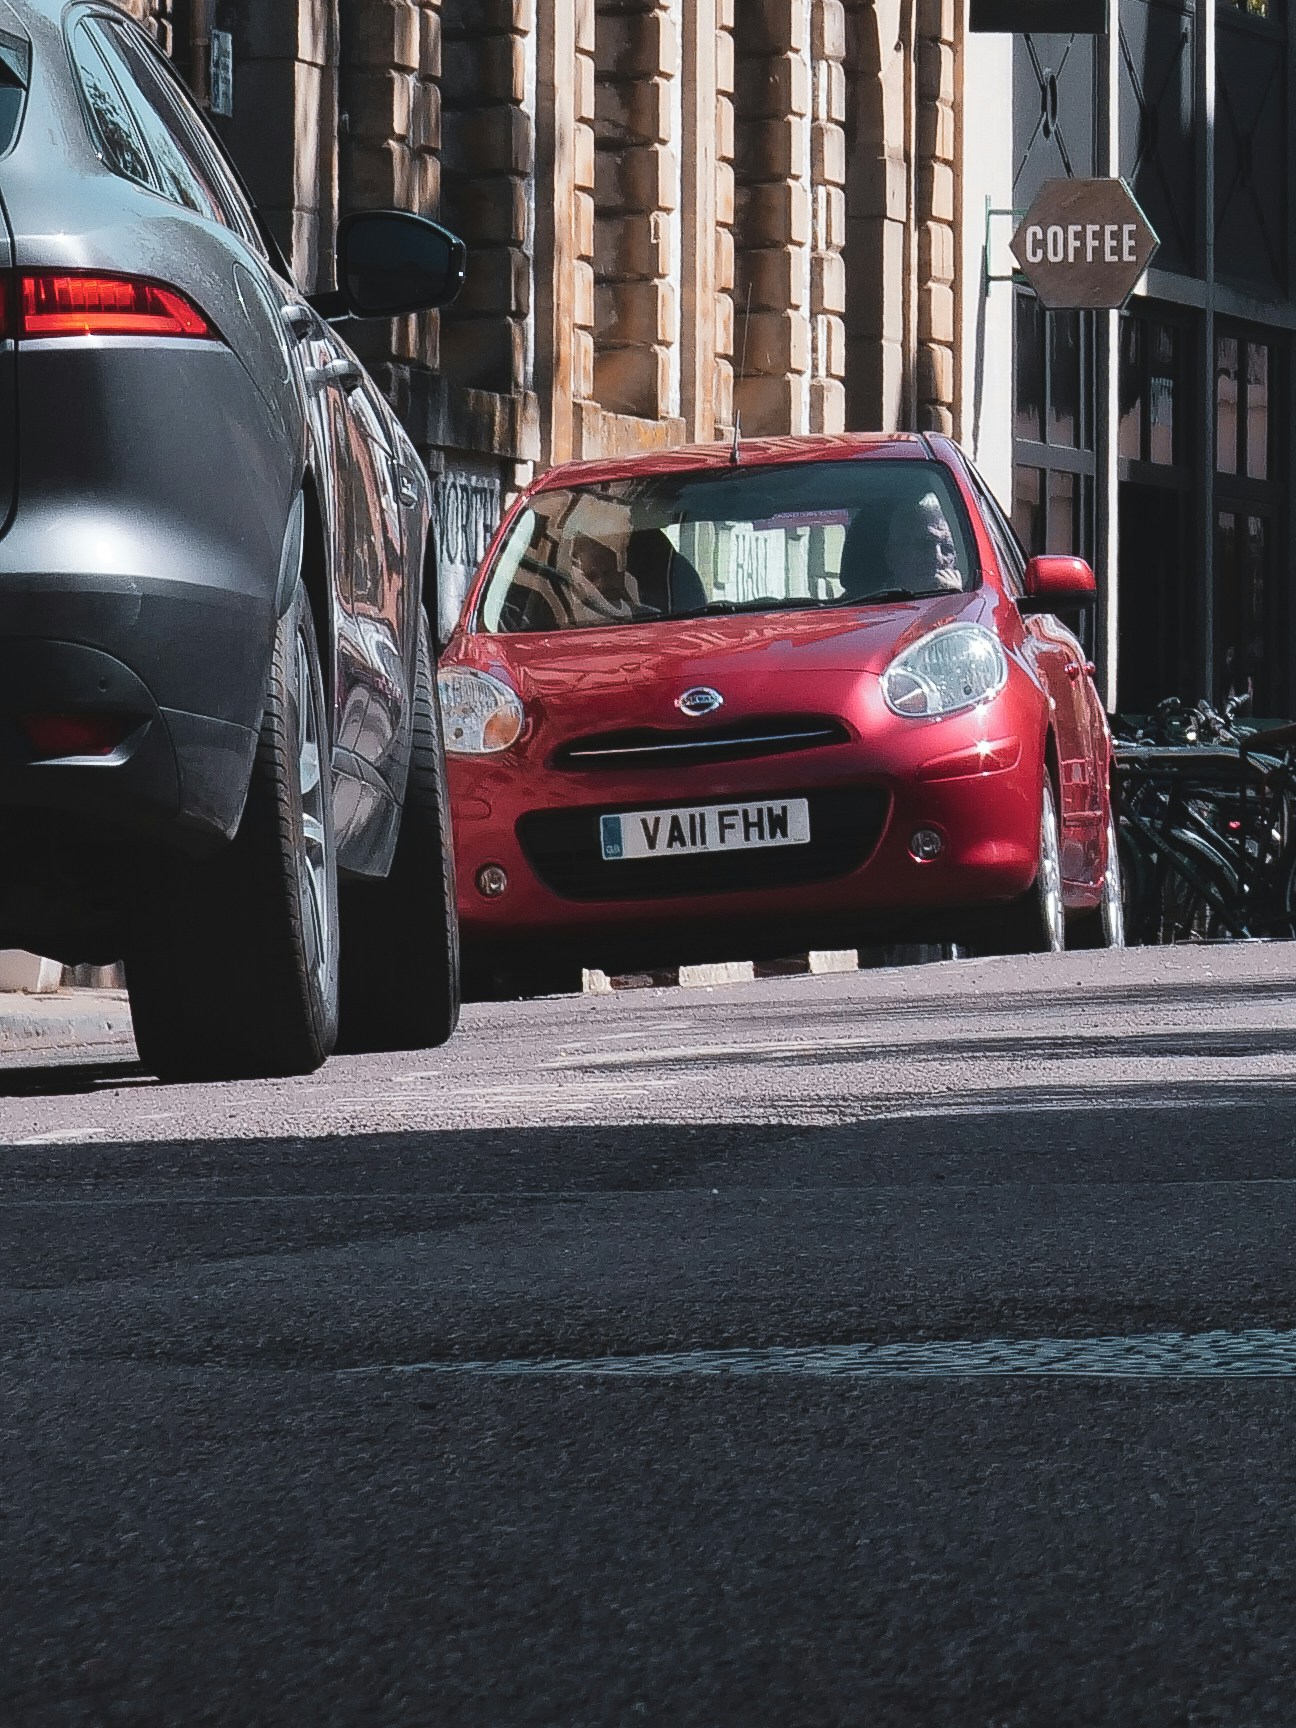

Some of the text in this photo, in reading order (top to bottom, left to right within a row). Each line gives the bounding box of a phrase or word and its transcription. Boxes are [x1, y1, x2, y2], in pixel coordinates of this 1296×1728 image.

[1025, 224, 1137, 263] COFFEE
[640, 805, 788, 850] VA11 FHW
